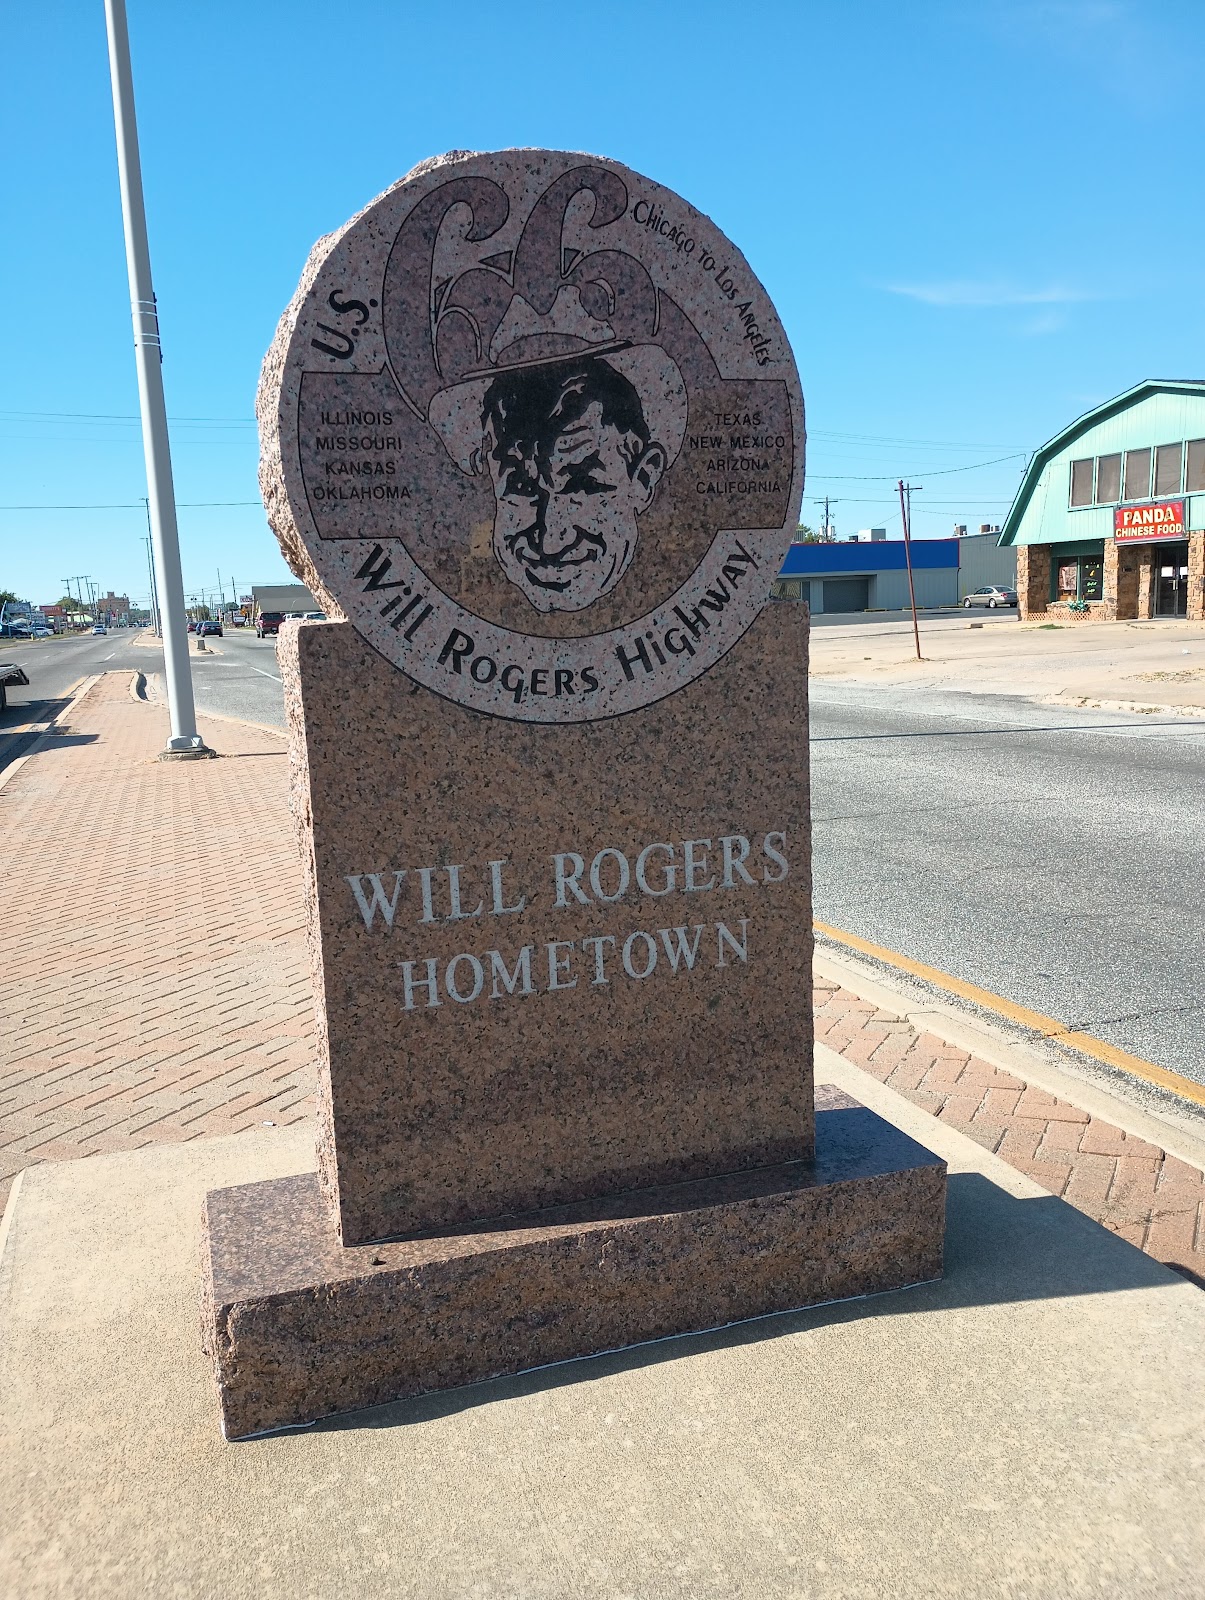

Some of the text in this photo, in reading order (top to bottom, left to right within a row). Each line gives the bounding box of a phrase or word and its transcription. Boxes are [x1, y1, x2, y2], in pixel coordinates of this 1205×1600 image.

[310, 289, 378, 360] U.S.
[321, 411, 394, 426] ILLINOIS
[714, 412, 762, 426] TEXAS
[316, 436, 402, 451] MISSOURI
[690, 435, 785, 449] NEW MEXICO
[325, 461, 396, 475] KANSAS
[707, 459, 770, 471] ARIZONA
[313, 486, 411, 500] OKLAHOMA
[696, 481, 781, 495] CALIFORNIA
[1123, 506, 1175, 526] PANDA
[1115, 523, 1182, 538] CHINESE FOOD
[344, 830, 790, 931] WILL ROGERS
[399, 918, 751, 1010] HOMETOWN
